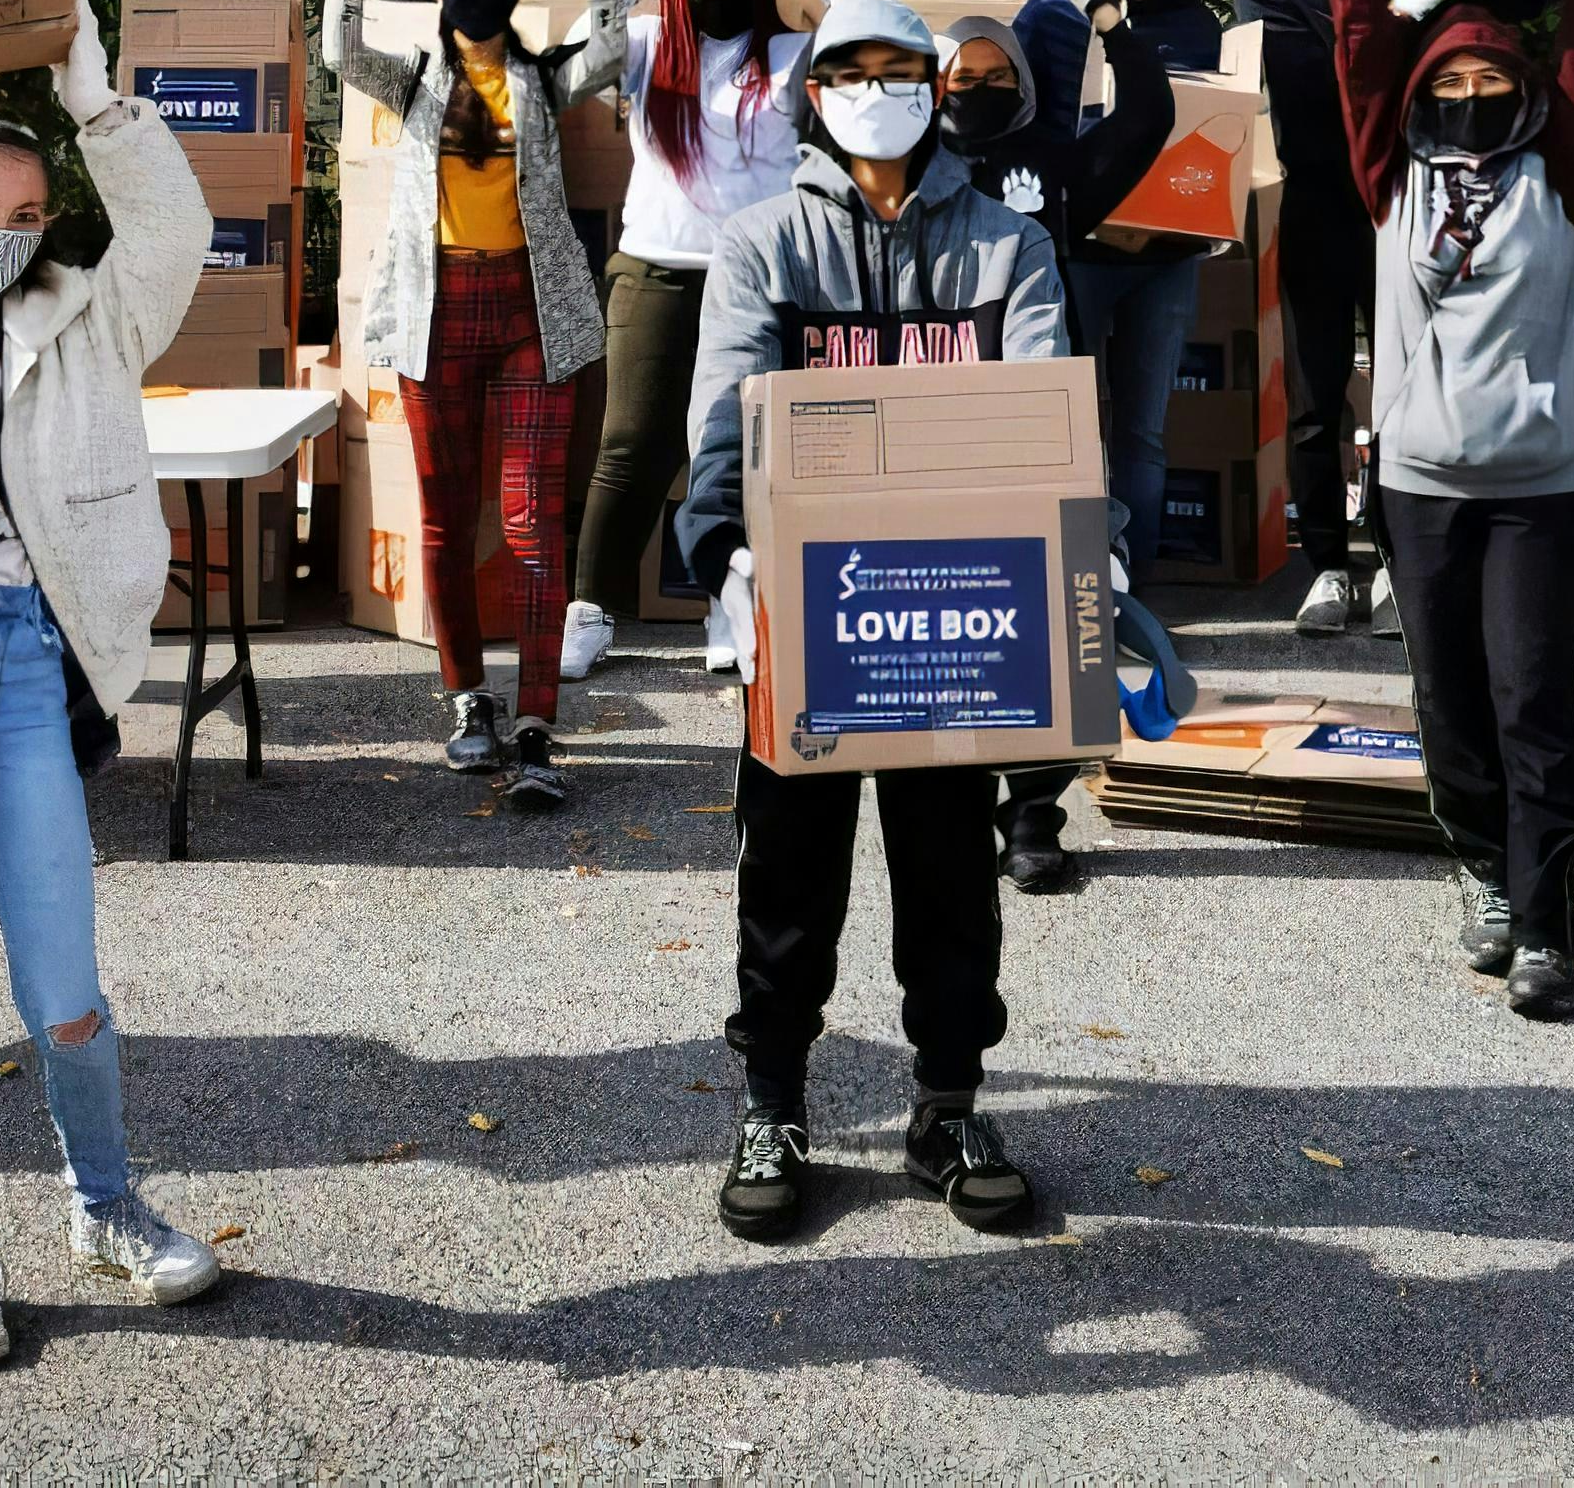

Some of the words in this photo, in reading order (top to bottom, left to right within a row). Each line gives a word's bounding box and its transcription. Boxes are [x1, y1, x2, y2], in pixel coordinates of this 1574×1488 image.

[835, 609, 930, 643] LOVE
[940, 607, 1019, 641] BOX
[1072, 571, 1103, 673] SMALL
